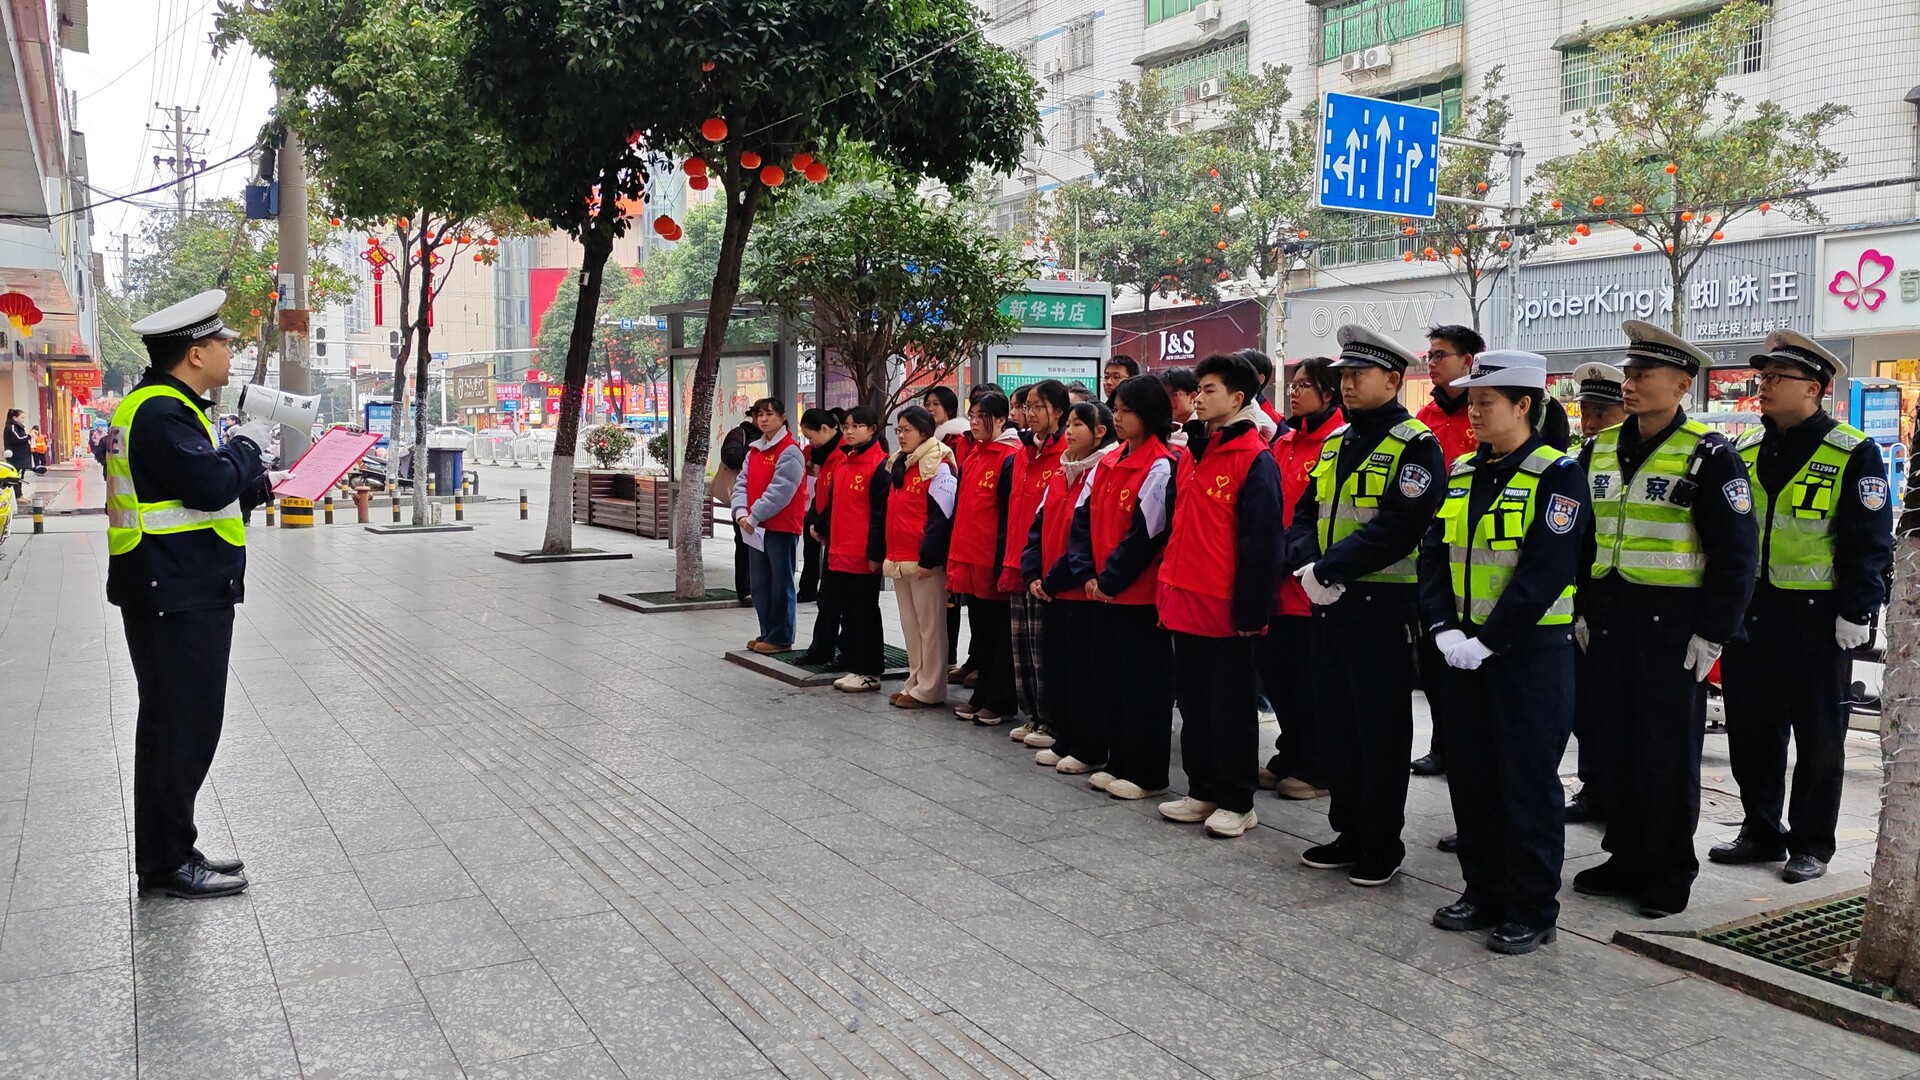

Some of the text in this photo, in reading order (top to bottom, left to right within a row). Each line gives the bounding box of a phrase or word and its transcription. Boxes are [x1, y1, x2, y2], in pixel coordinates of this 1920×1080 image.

[1689, 271, 1799, 311] 蜘蛛王
[1008, 299, 1086, 322] 新华书店
[1159, 330, 1195, 361] J&S
[283, 395, 313, 410] 警察
[1811, 462, 1838, 474] E12984
